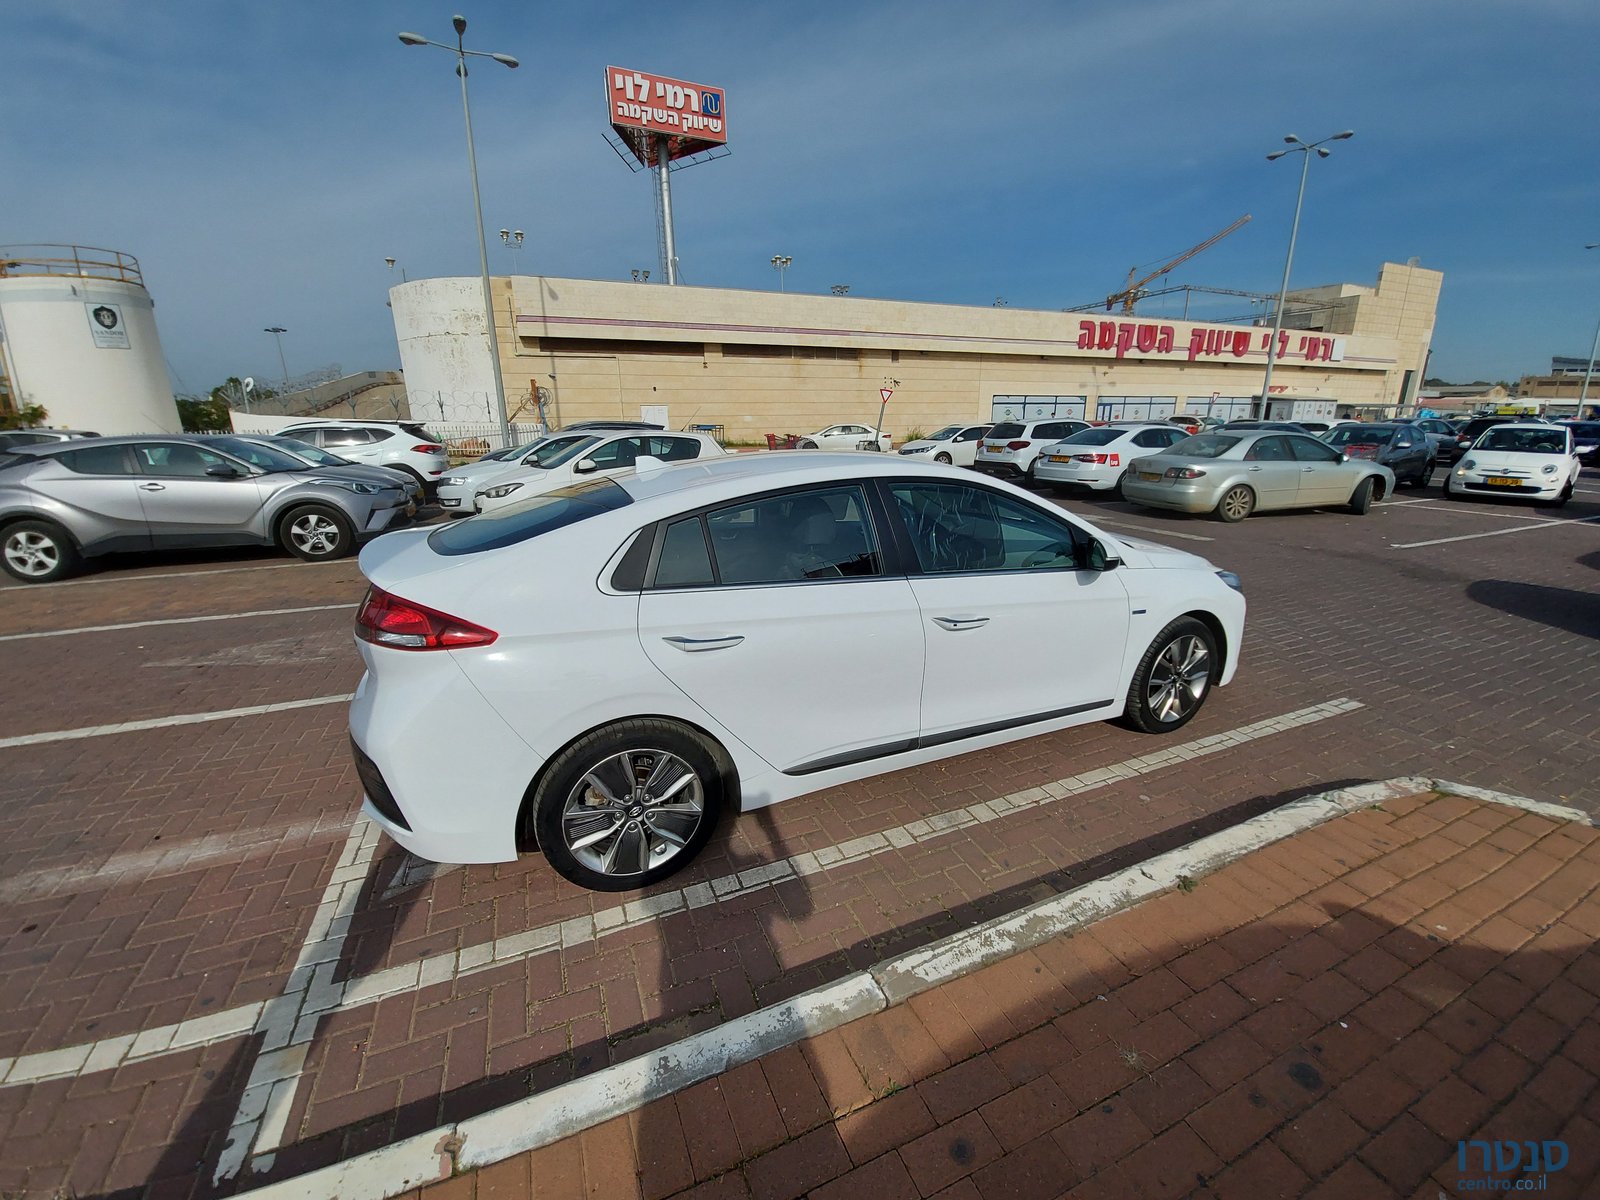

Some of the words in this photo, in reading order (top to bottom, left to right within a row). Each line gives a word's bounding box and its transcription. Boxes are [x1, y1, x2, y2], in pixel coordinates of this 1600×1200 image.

[614, 72, 650, 102] לוי
[655, 82, 699, 112] רמי
[616, 101, 680, 126] השקמה
[681, 112, 722, 133] שיווק
[1077, 320, 1175, 361] השקמה
[1188, 327, 1252, 362] שיווק
[1261, 330, 1290, 359] לי
[1299, 336, 1332, 362] רמי
